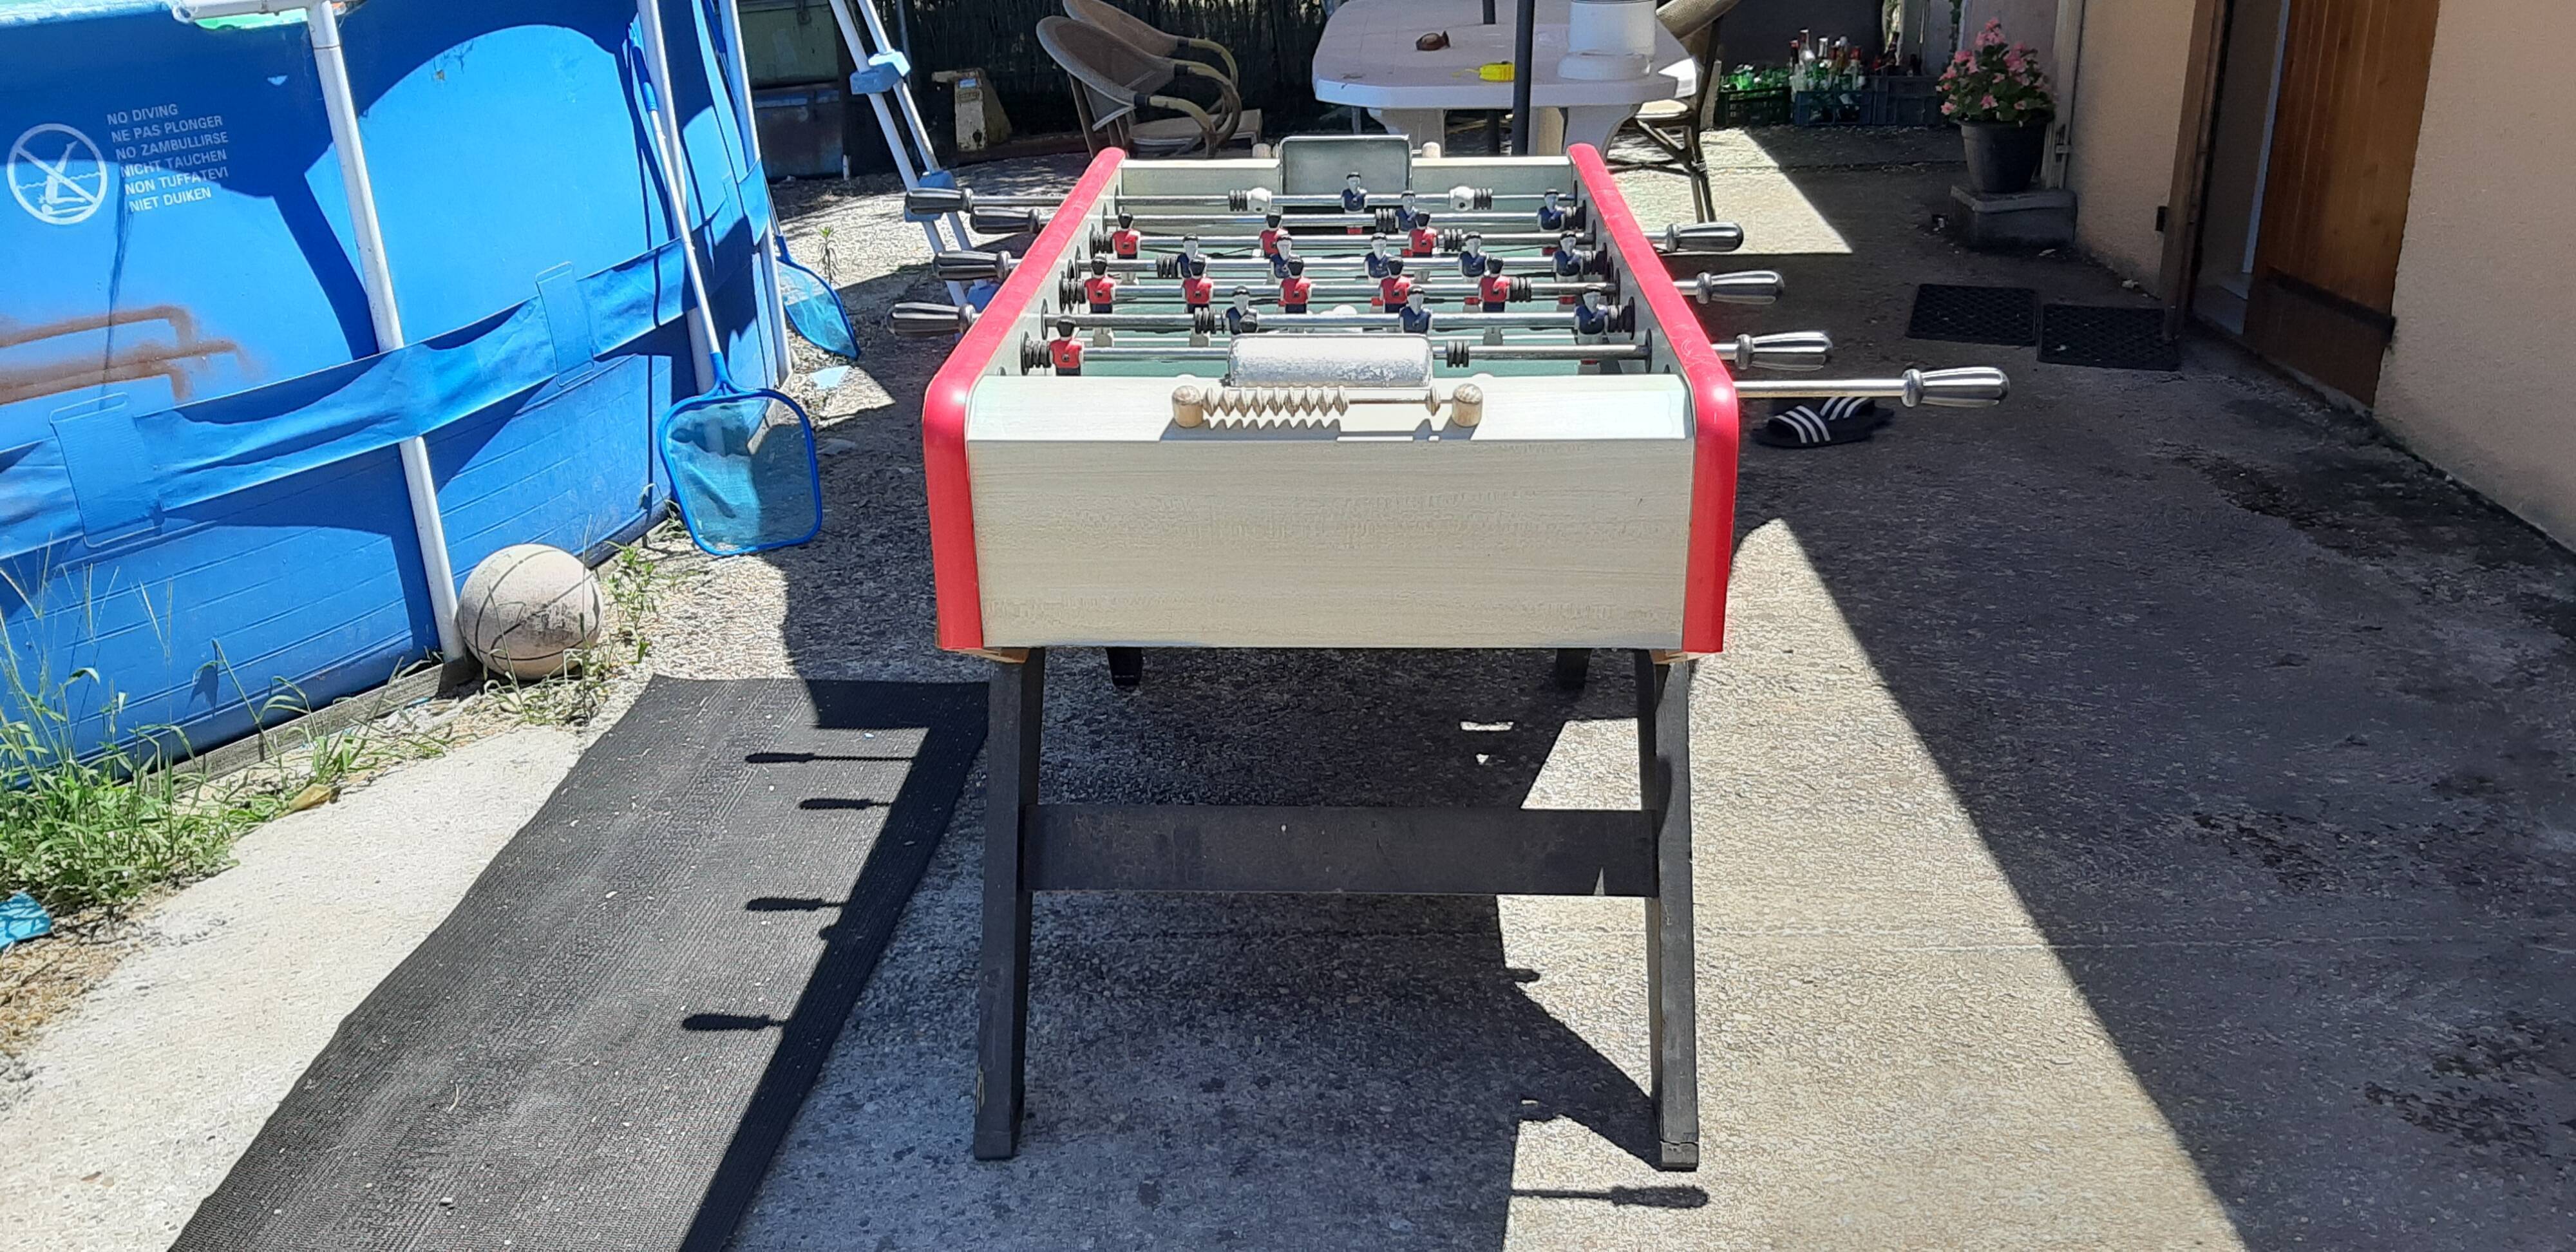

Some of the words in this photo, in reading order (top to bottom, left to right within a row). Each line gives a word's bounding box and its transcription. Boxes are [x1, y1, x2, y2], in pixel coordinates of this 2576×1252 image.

[107, 111, 128, 125] NO
[133, 104, 178, 120] DIVING
[111, 129, 131, 143] NE
[133, 124, 160, 138] PAS
[164, 115, 223, 134] PLONGER
[115, 146, 136, 160] NO
[140, 132, 228, 156] ZAMBULLIRSE
[120, 162, 161, 178] NICHT
[164, 149, 227, 169] TAUCHEN
[124, 179, 155, 195] NON
[158, 167, 228, 188] TUFFATEVI
[129, 196, 158, 213] NIET
[164, 187, 211, 206] DUIKEN
